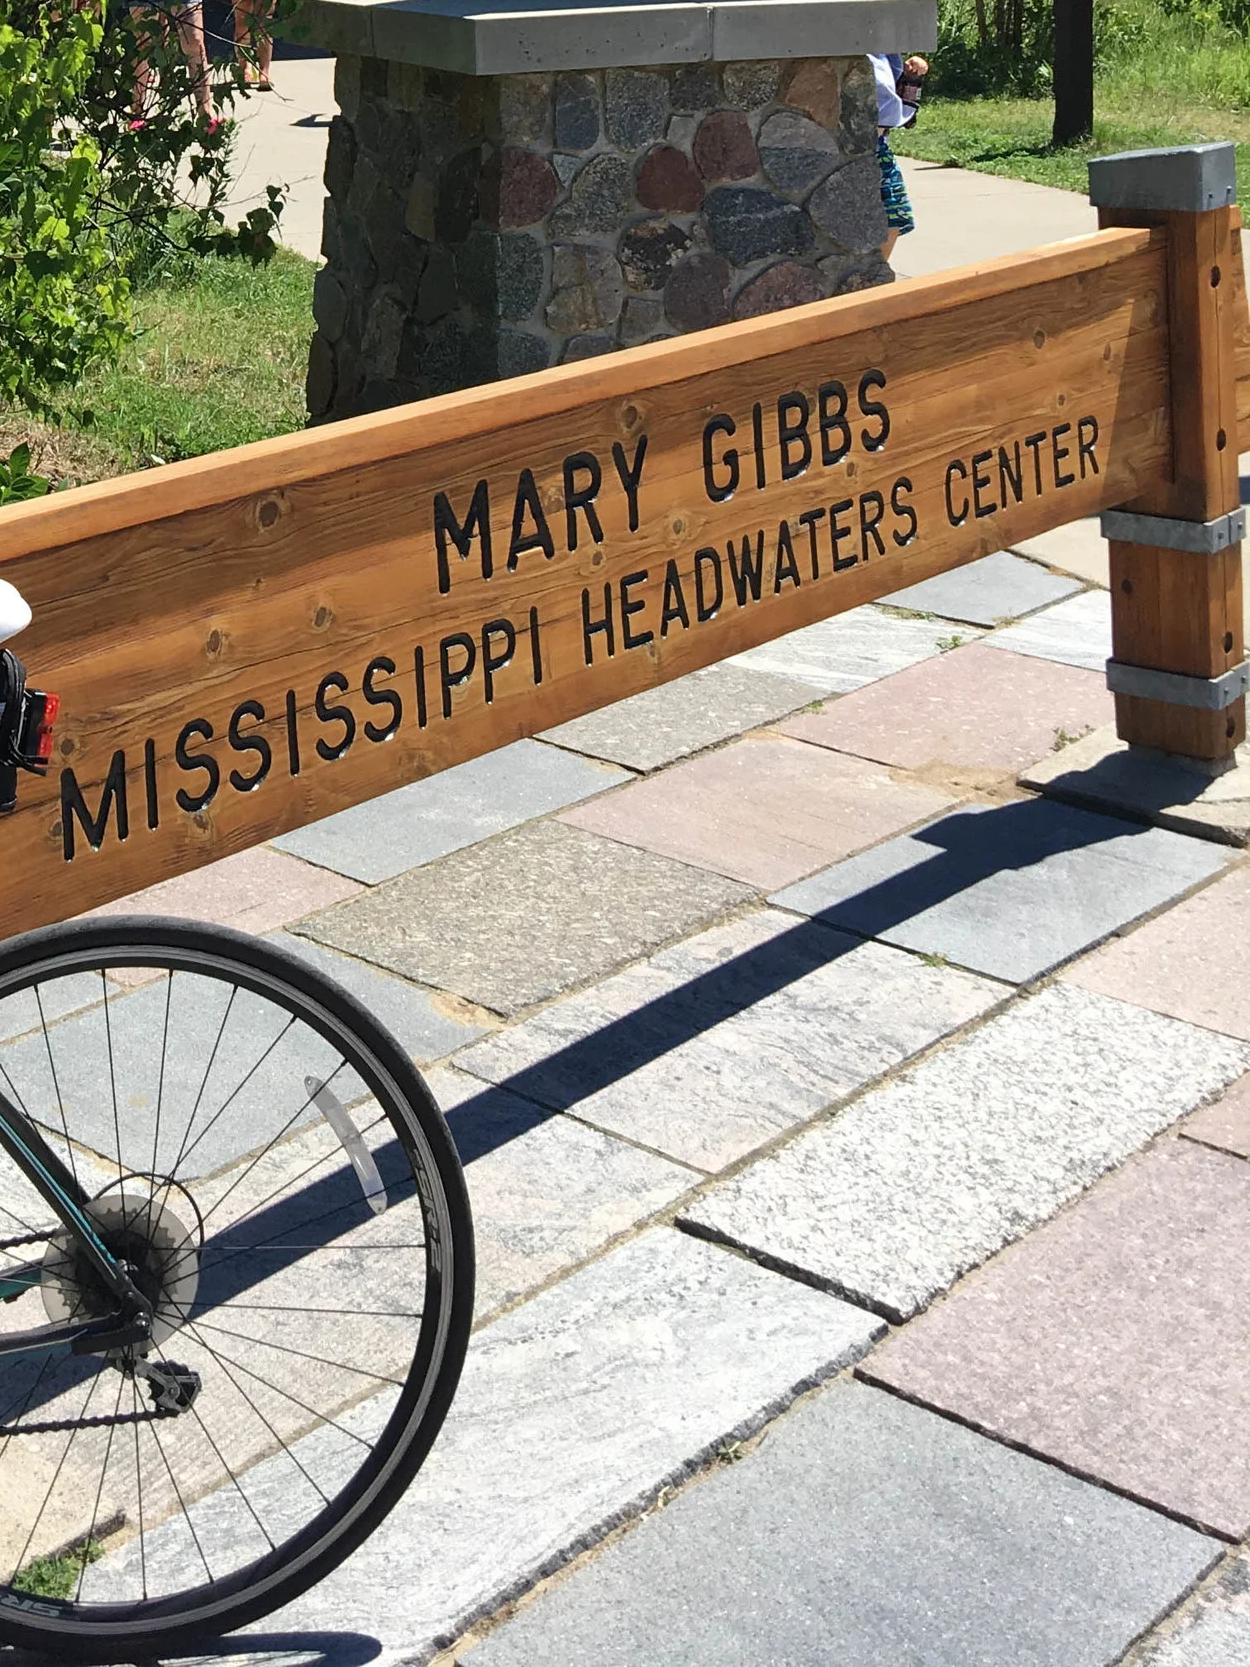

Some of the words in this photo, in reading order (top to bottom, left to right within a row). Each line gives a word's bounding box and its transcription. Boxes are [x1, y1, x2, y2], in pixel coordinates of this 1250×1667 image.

[60, 605, 543, 862] MISSISSIPPI
[581, 476, 918, 667] HEADWATERS
[944, 415, 1100, 528] CENTER
[433, 434, 647, 596] MARY
[703, 368, 891, 503] GIBBS
